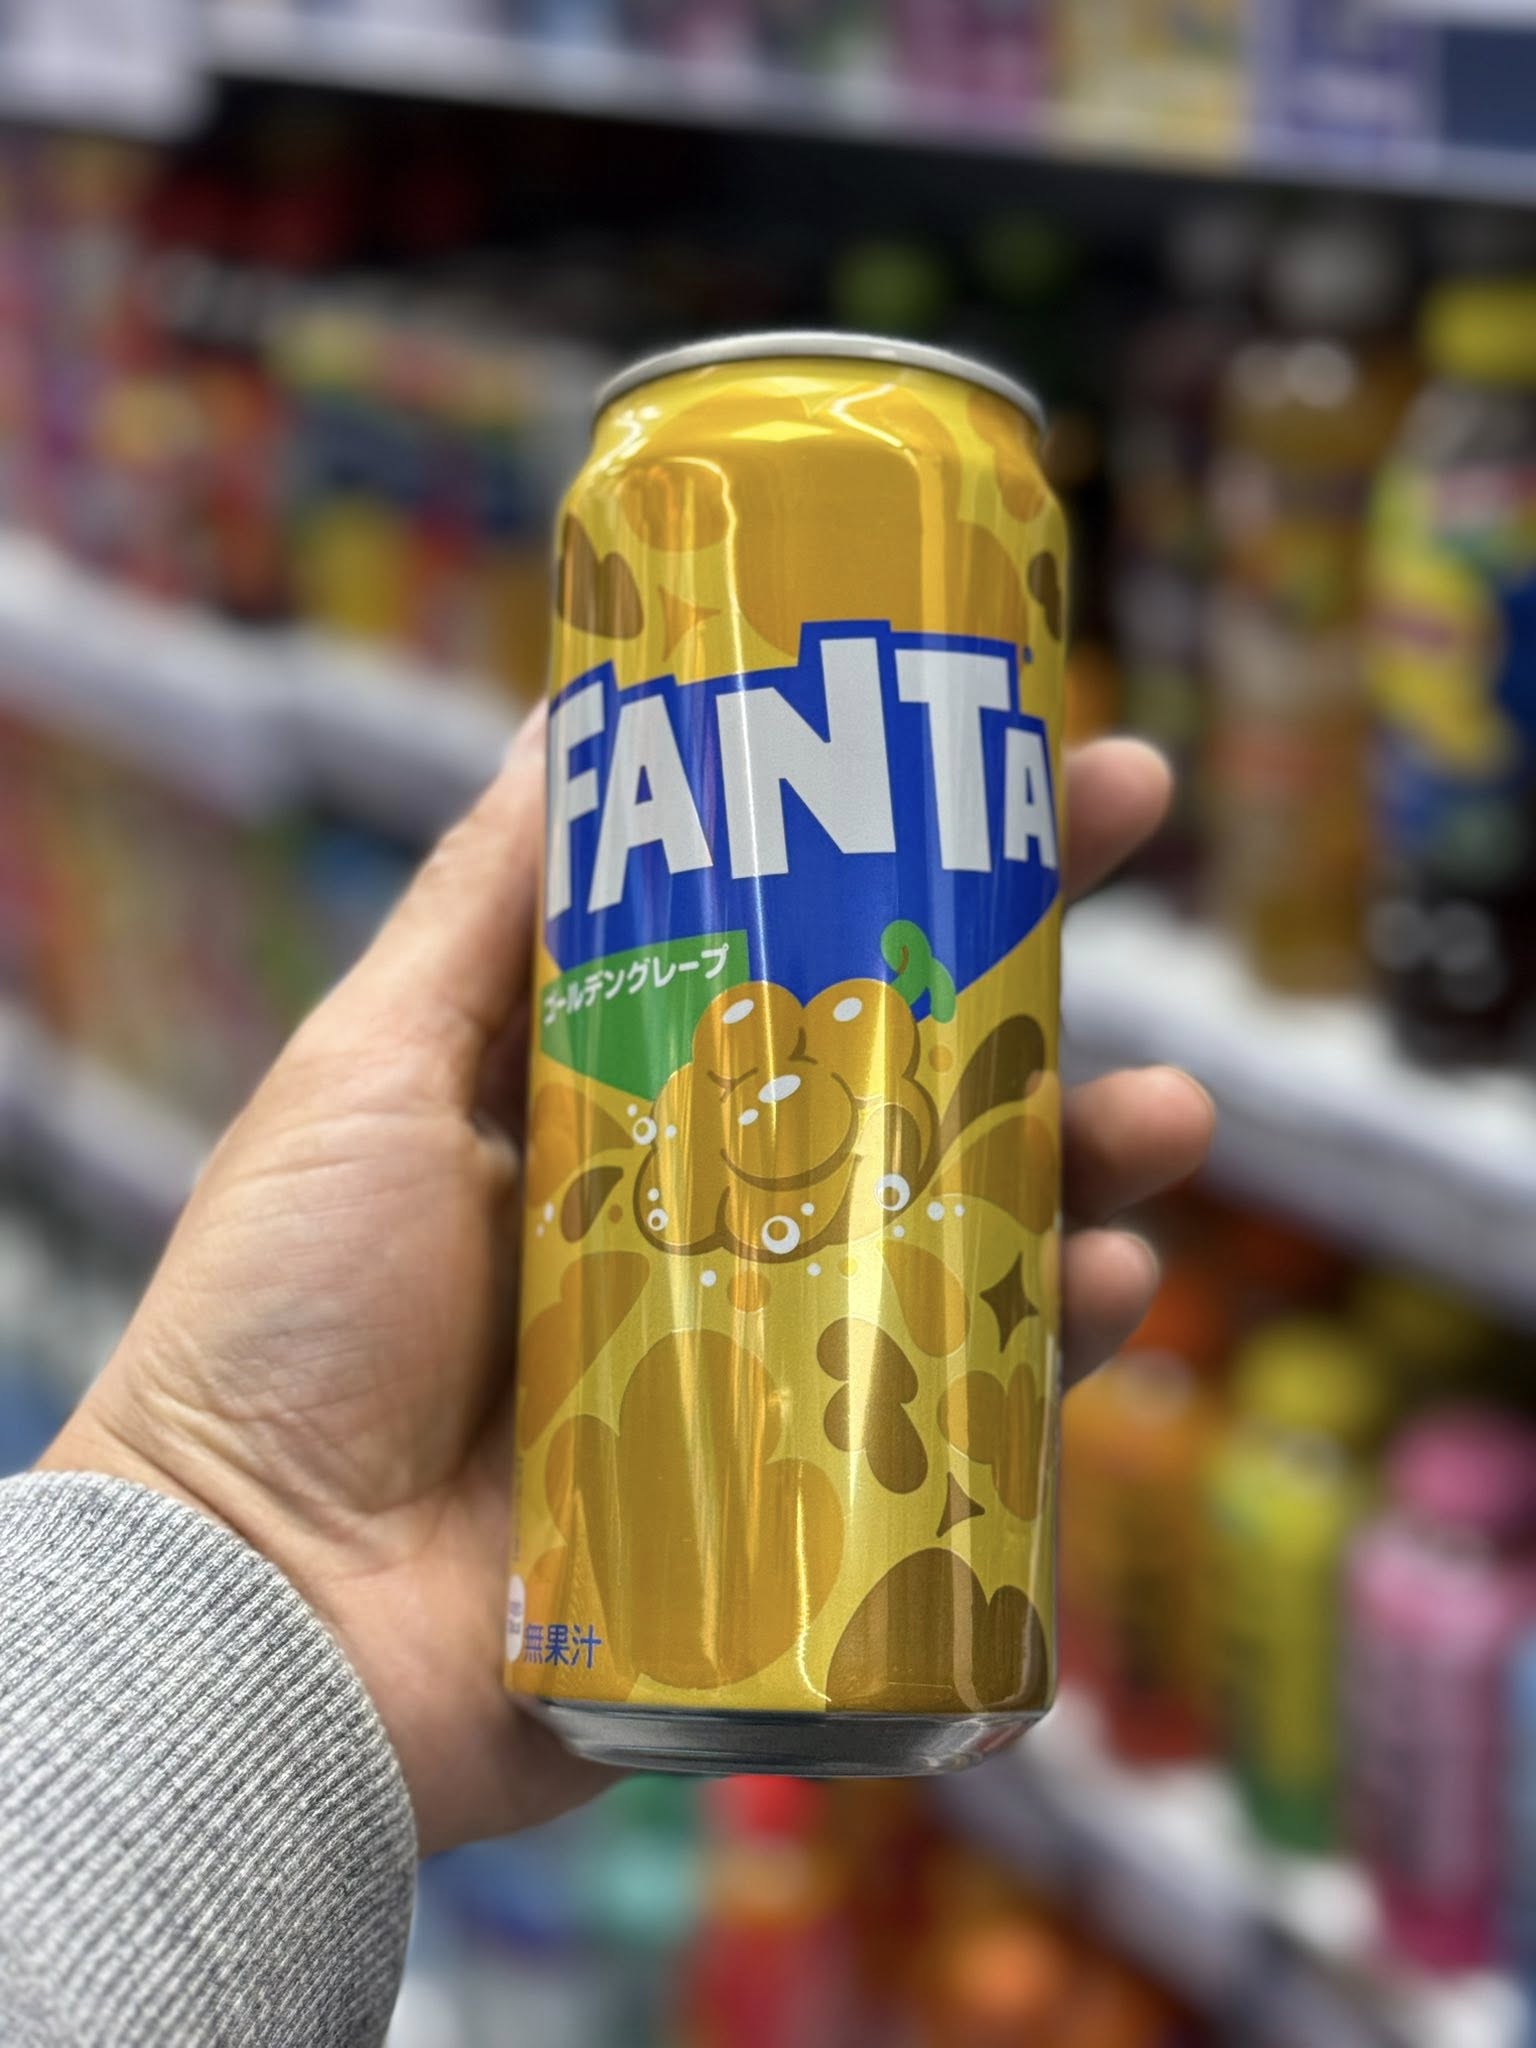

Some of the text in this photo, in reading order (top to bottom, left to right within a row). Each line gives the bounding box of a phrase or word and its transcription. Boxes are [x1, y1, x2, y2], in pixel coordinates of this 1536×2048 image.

[547, 637, 1057, 921] FANTA
[544, 942, 730, 1025] ゴールデングレープ
[524, 1623, 602, 1669] 無果汁
